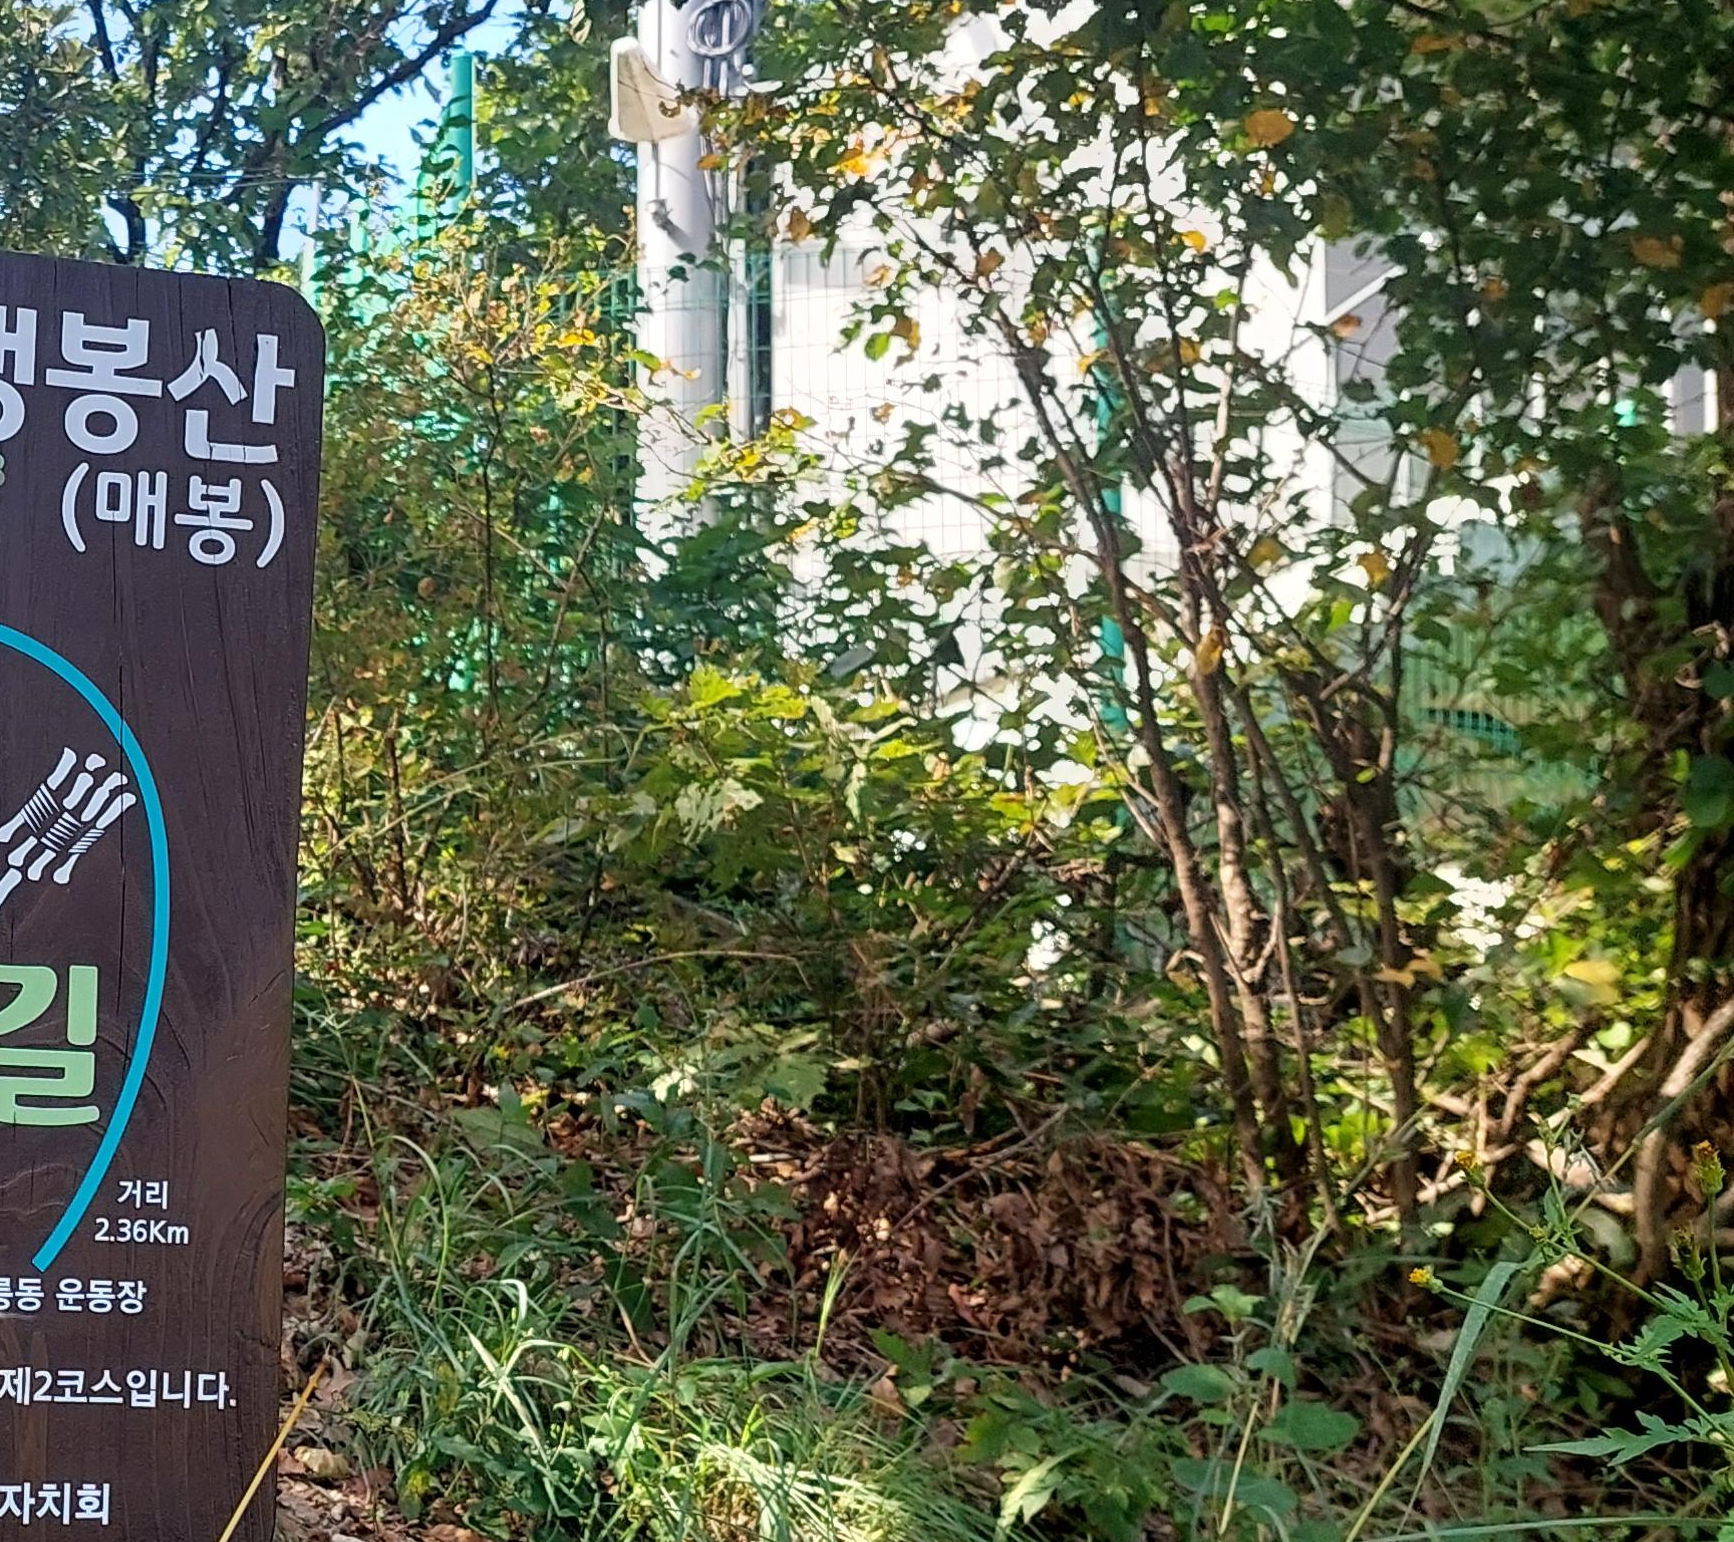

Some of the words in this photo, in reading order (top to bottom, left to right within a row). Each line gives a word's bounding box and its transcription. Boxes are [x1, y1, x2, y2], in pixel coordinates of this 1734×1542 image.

[61, 461, 286, 568] (매봉)
[117, 1179, 169, 1211] 거리
[93, 1217, 190, 1246] 2.36Km
[54, 1277, 148, 1315] 운동장
